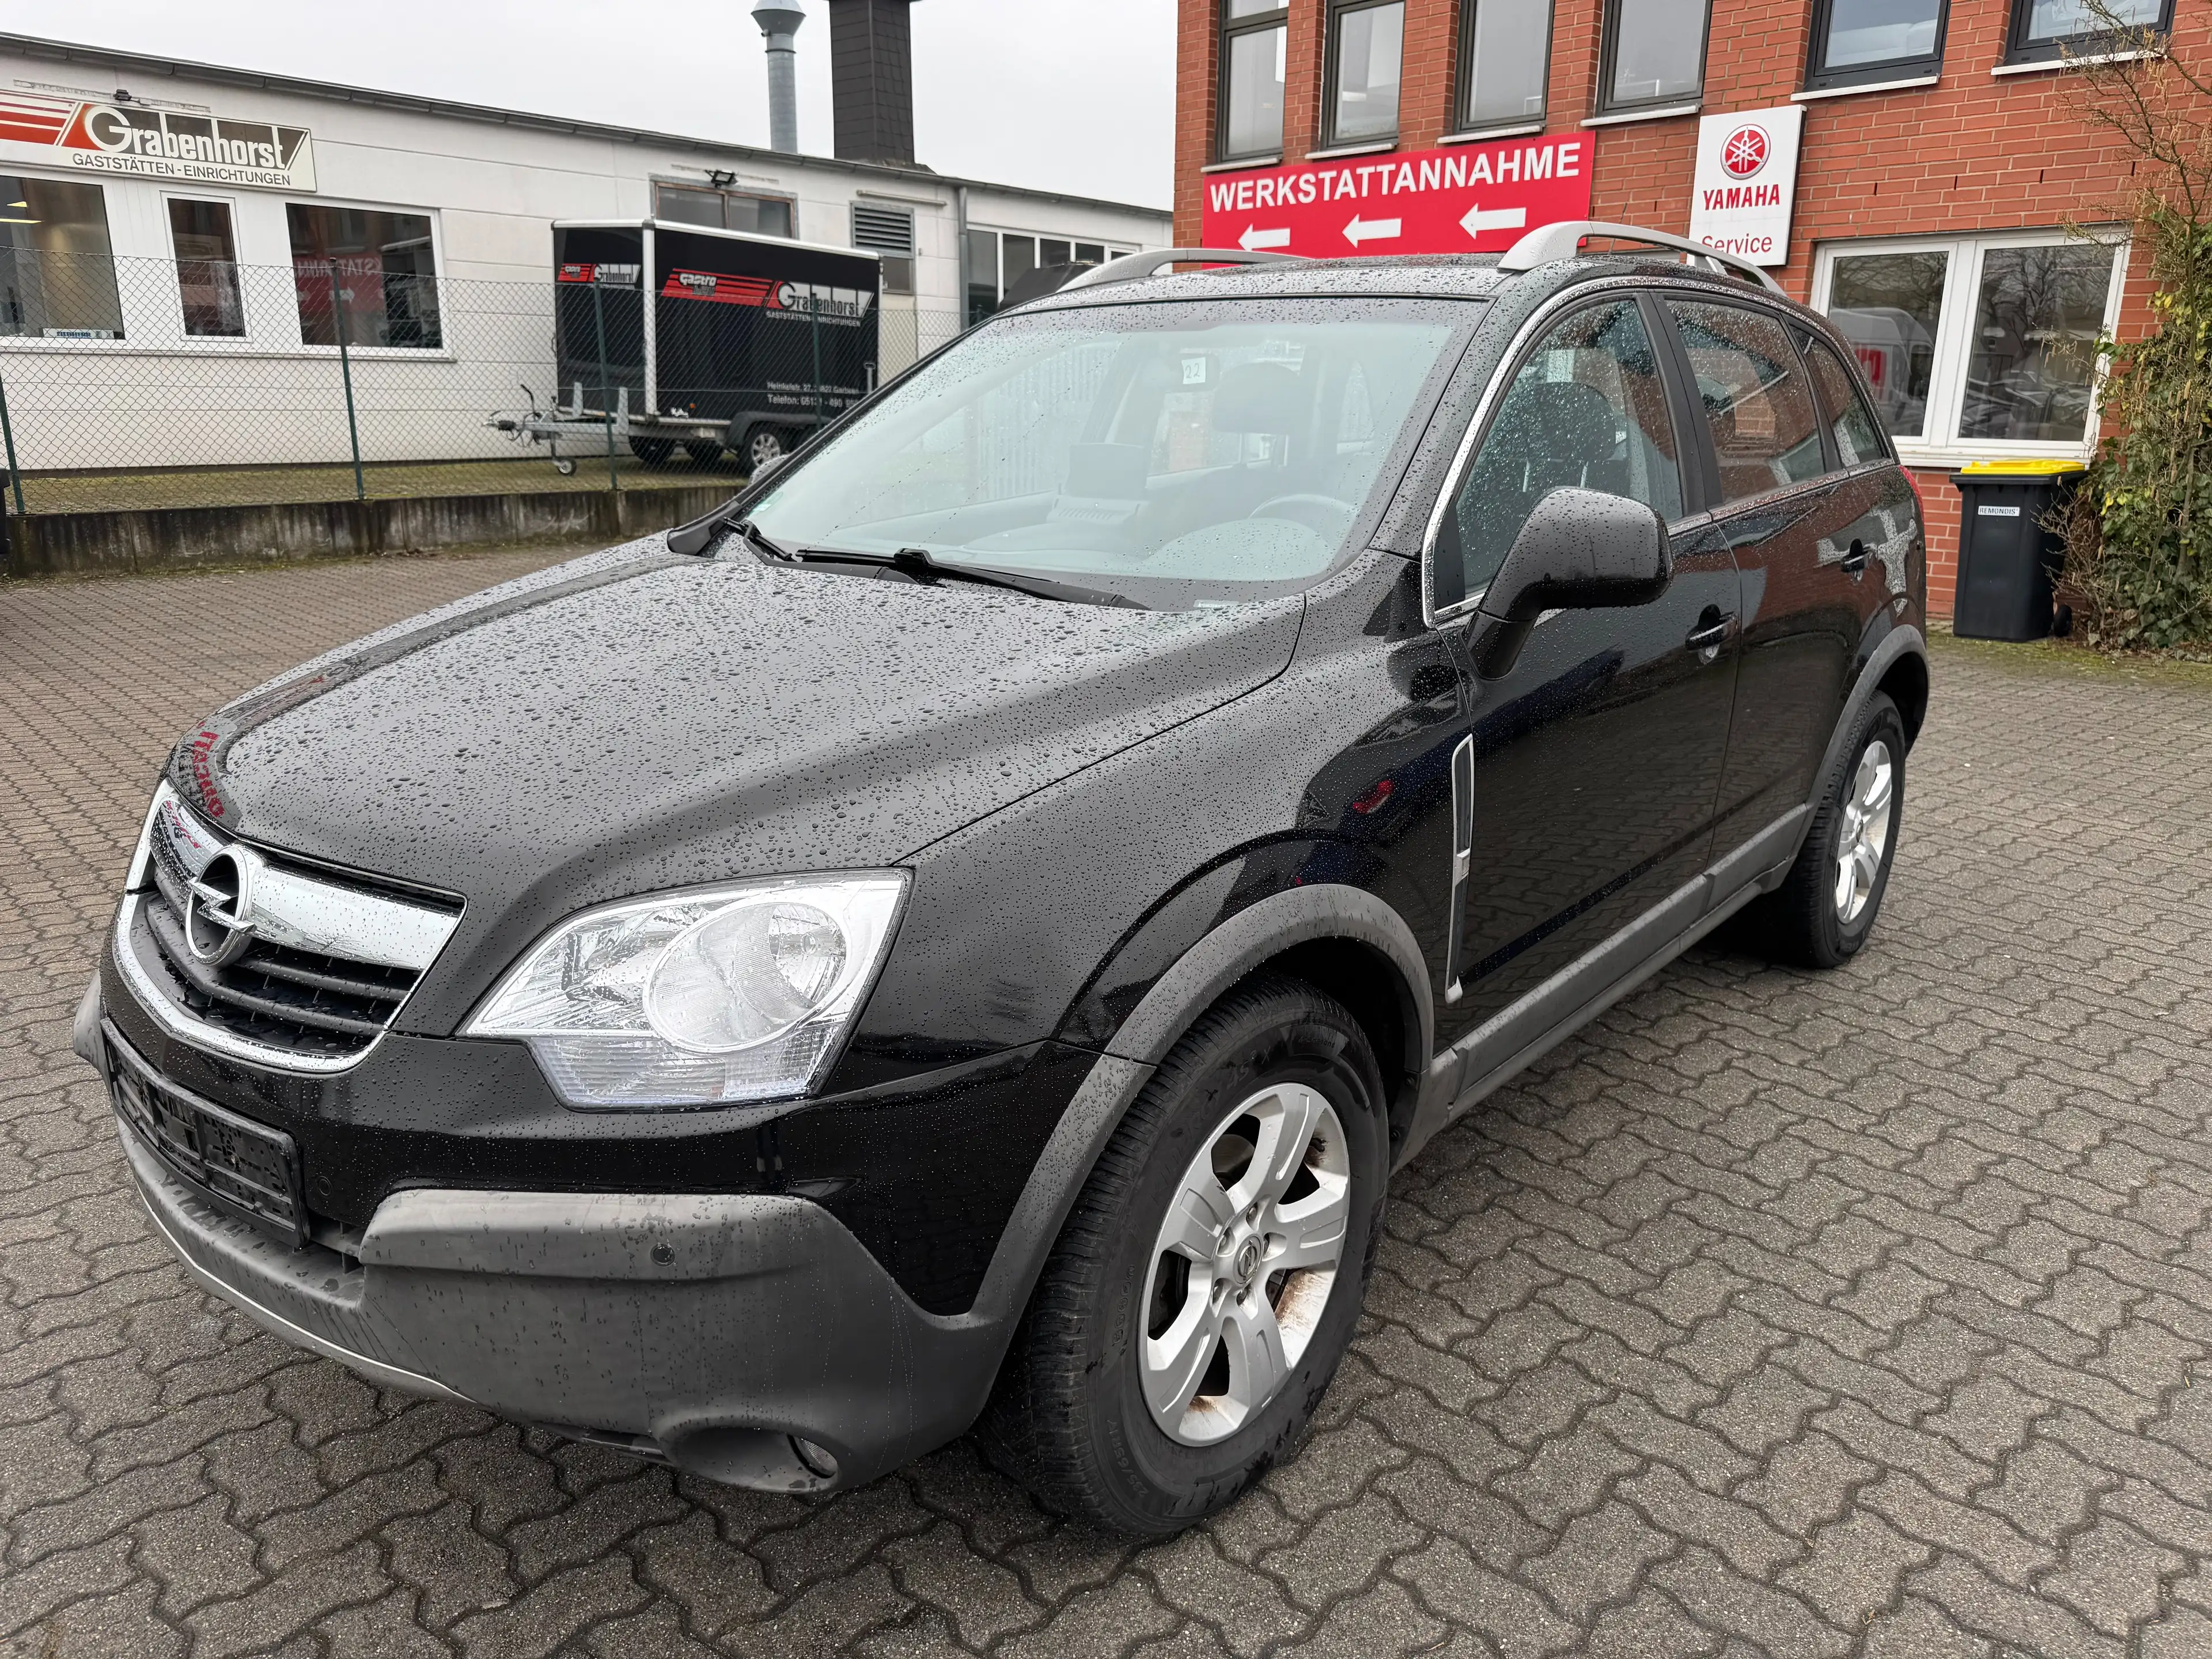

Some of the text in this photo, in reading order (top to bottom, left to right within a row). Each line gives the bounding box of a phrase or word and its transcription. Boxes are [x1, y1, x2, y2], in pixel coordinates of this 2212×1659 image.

[85, 105, 286, 170] Grabenhorst
[1210, 142, 1581, 213] WERKSTATTANNAHME
[1703, 184, 1780, 211] YAMAHA
[1702, 233, 1772, 254] Service
[1185, 362, 1200, 379] 22
